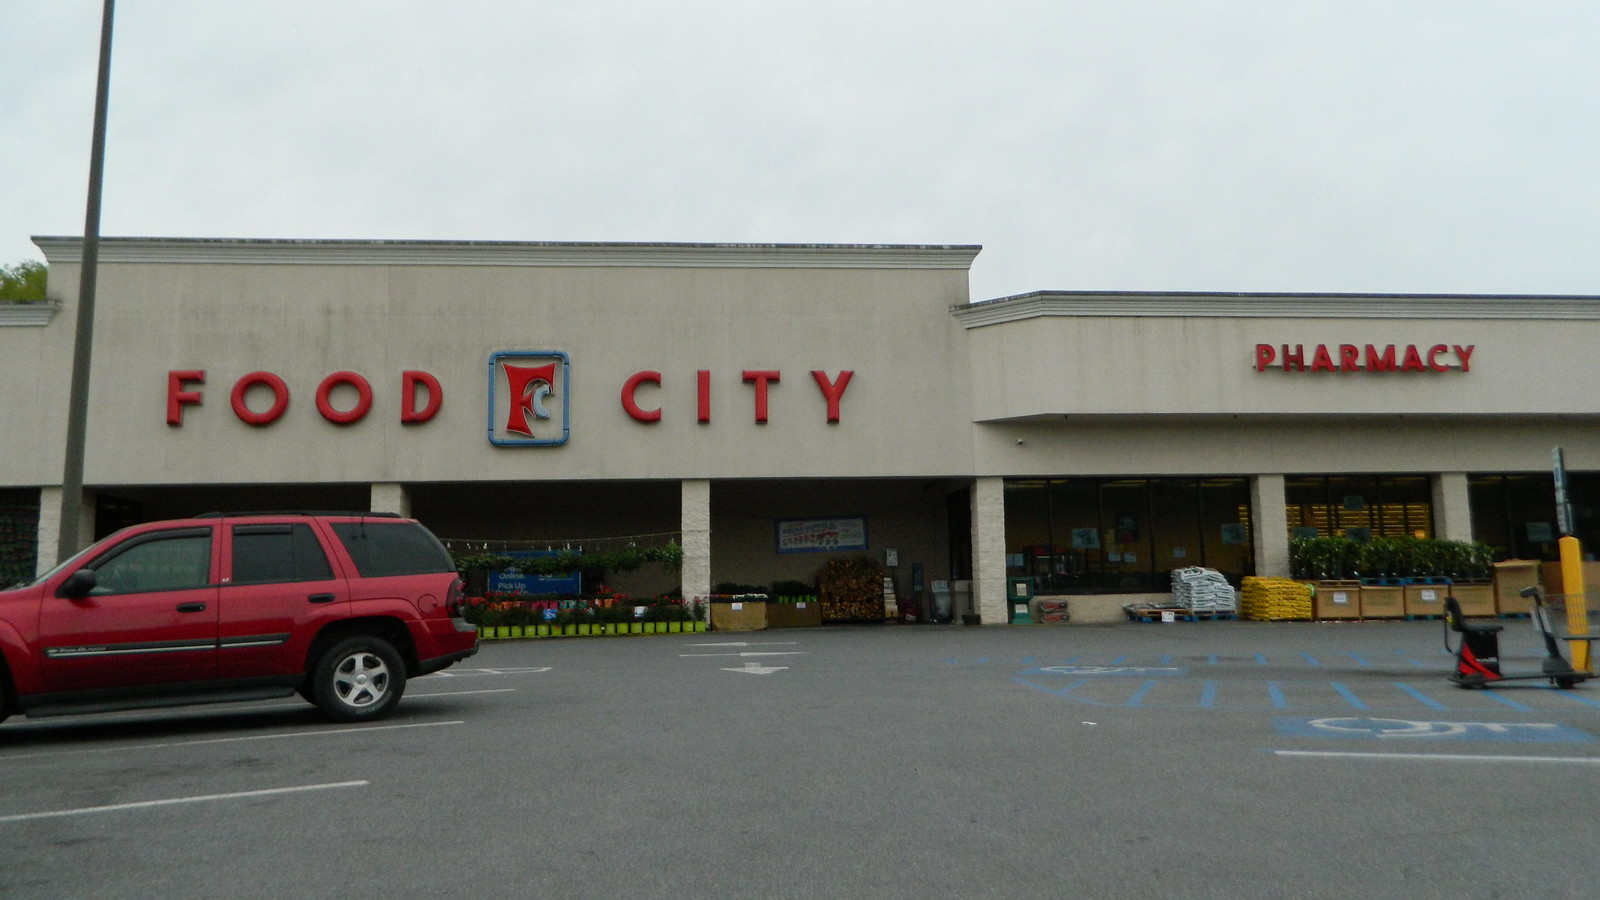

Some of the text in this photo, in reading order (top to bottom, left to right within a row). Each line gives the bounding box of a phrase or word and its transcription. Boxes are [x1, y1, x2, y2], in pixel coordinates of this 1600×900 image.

[1256, 344, 1475, 372] PHARMACY
[167, 370, 854, 426] FOOD CITY
